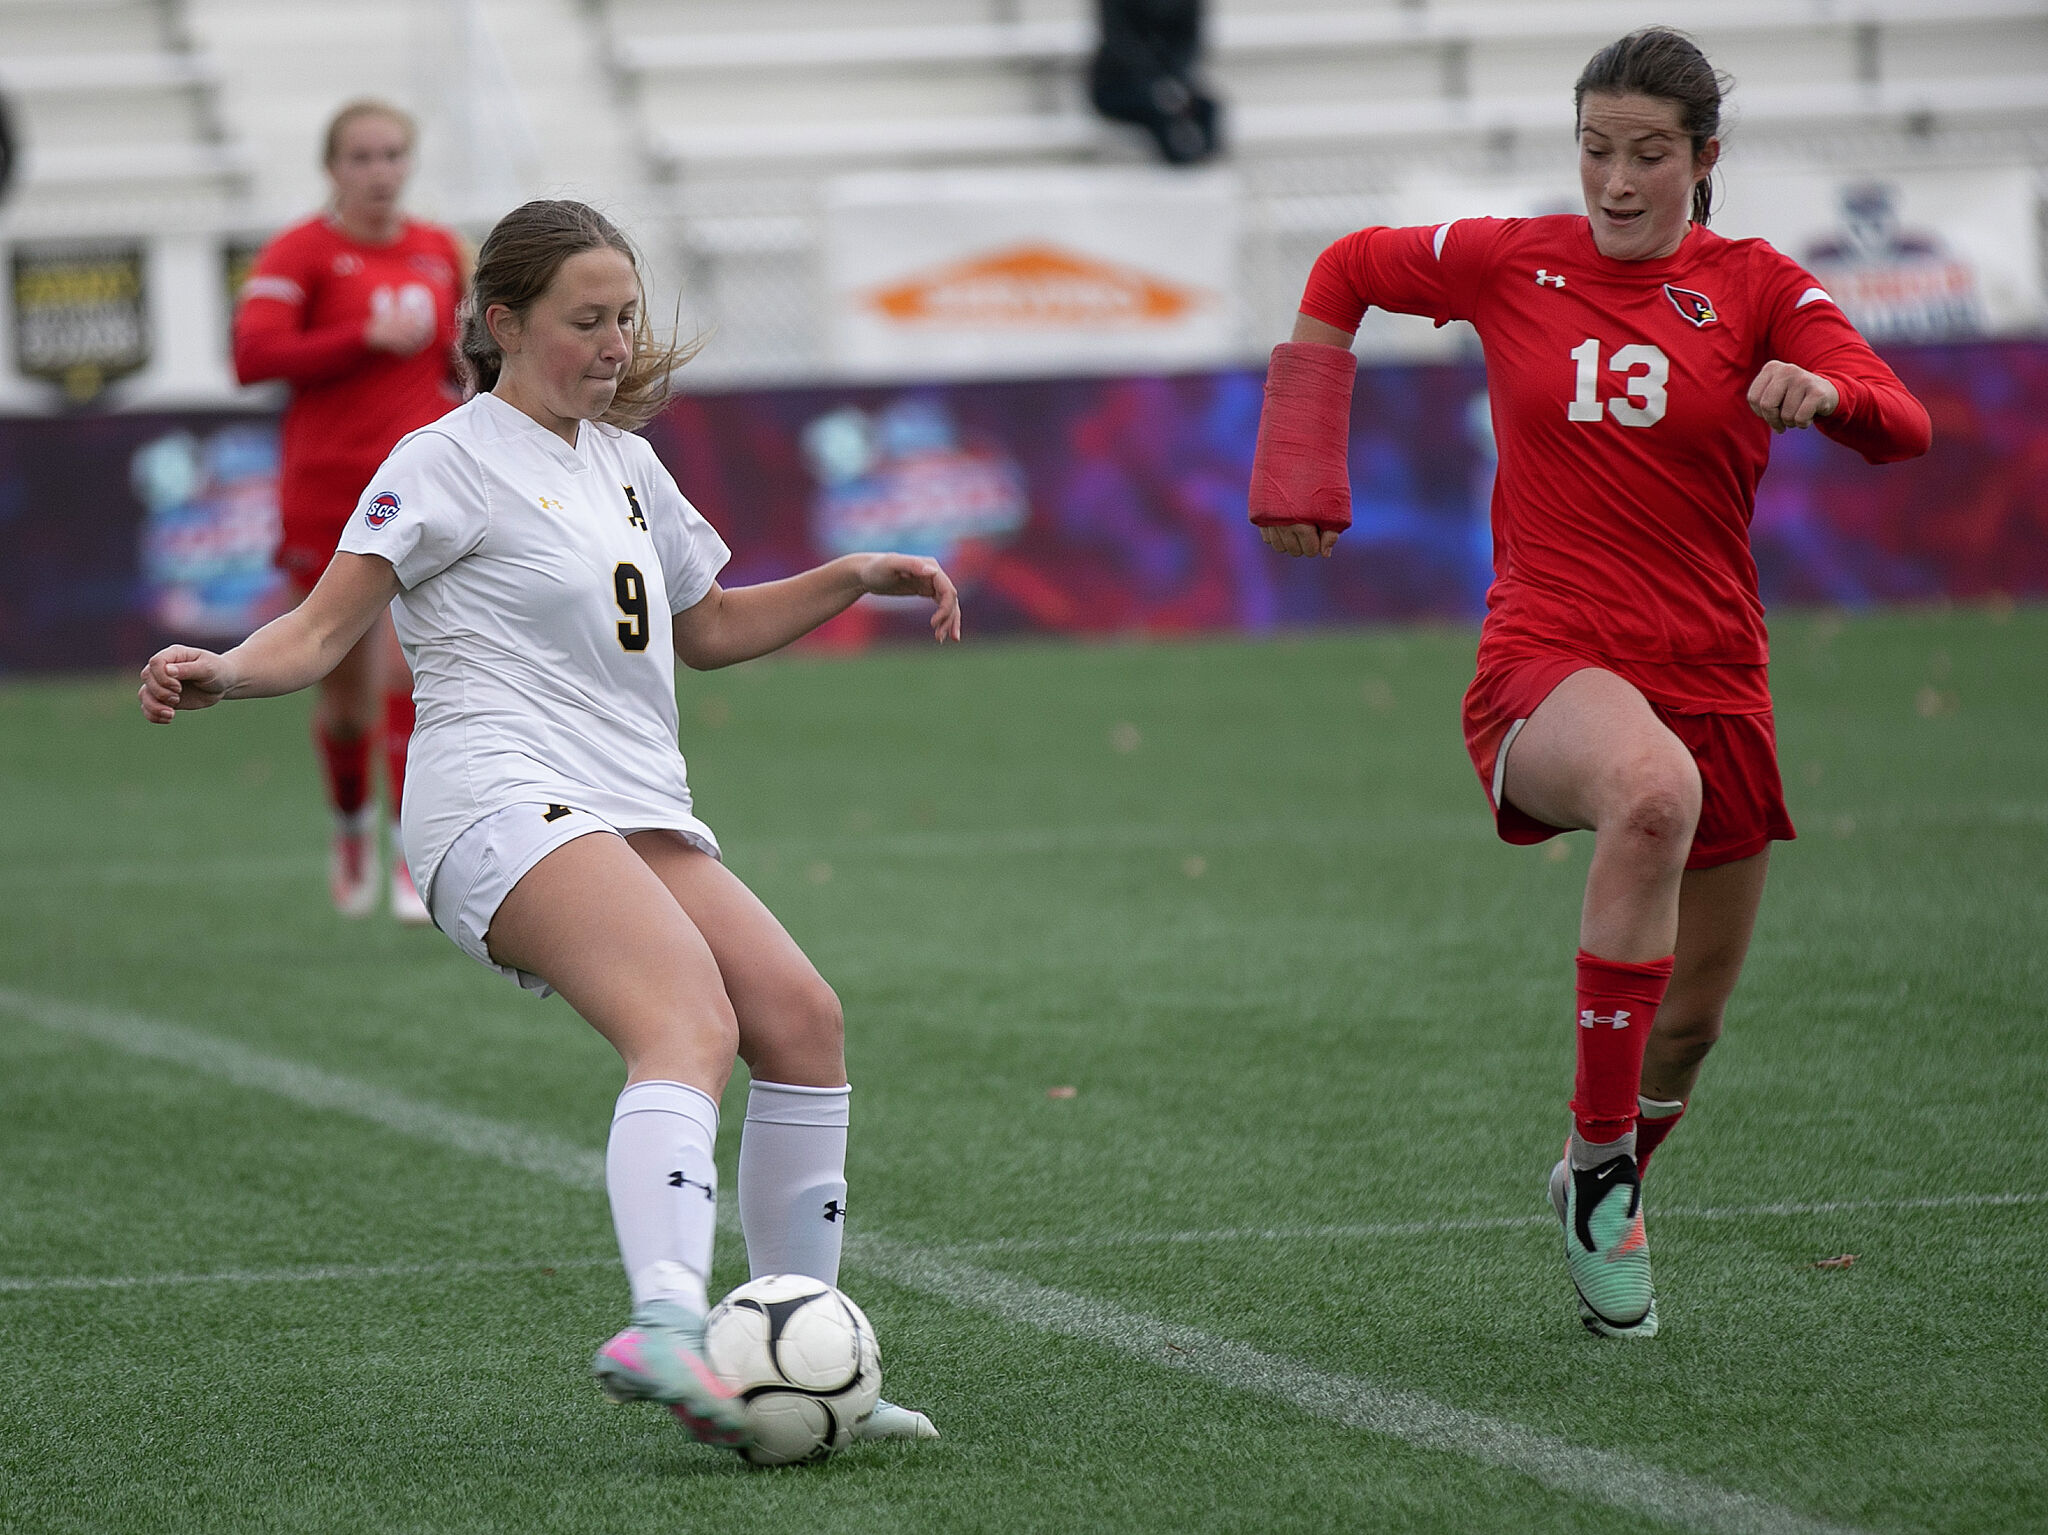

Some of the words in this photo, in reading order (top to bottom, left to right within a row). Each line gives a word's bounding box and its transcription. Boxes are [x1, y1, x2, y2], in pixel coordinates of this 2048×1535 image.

[1567, 338, 1670, 428] 13
[367, 502, 400, 519] SCC
[612, 561, 650, 653] 9
